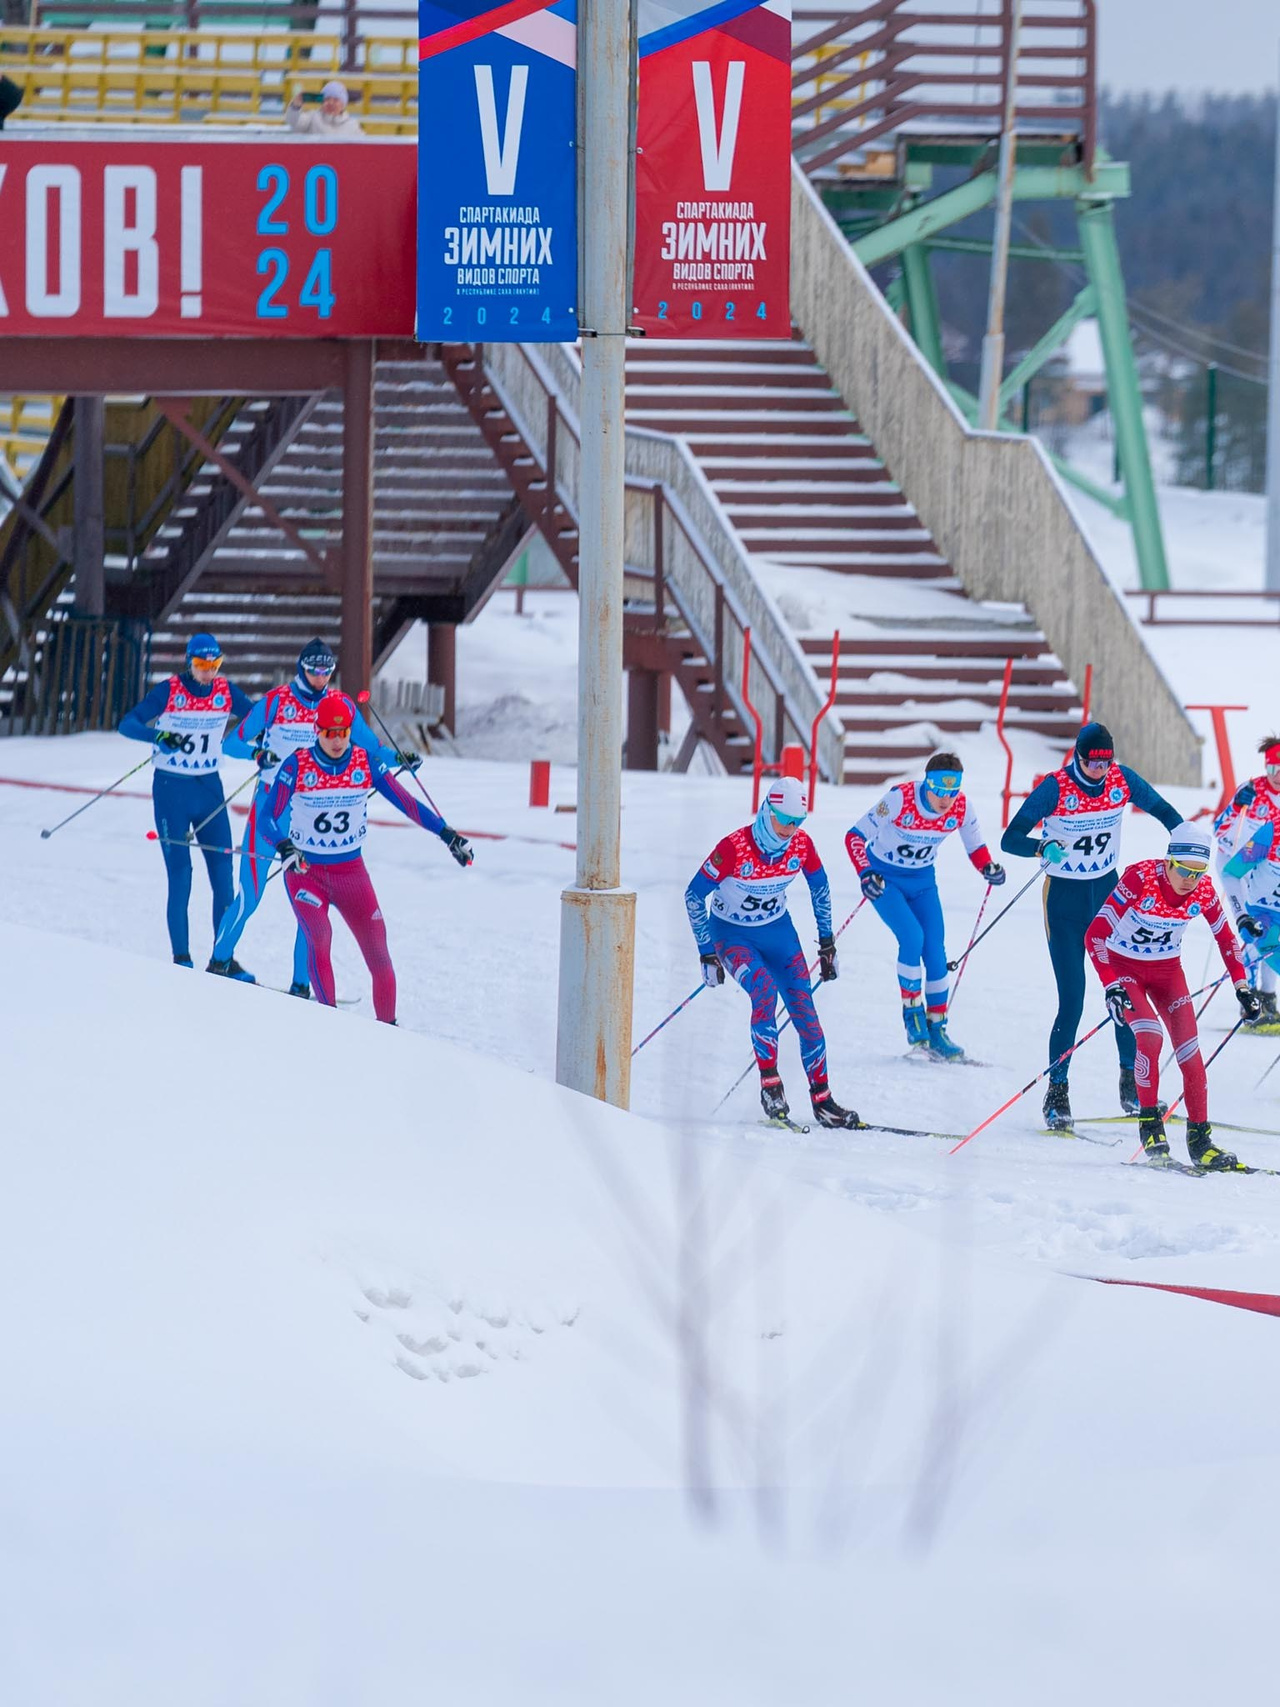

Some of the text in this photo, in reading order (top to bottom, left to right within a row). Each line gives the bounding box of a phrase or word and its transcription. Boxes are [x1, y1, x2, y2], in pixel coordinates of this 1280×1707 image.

[474, 65, 529, 195] V
[692, 61, 745, 191] V
[256, 163, 338, 236] 20
[676, 201, 754, 221] СПАРТАКИАДА
[459, 206, 541, 225] СПАРТАКИАДА
[0, 163, 203, 319] ОВ!
[443, 226, 553, 265] ЗИМНИХ
[661, 221, 767, 261] ЗИМНИХ
[256, 247, 337, 319] 24
[457, 267, 540, 286] ВИДОВ СПОРТА
[673, 262, 755, 282] ВИДОВ СПОРТА
[180, 733, 209, 755] 61
[313, 811, 350, 834] 63
[896, 844, 933, 860] 60
[1072, 832, 1112, 856] 49
[740, 894, 779, 912] 56
[1131, 926, 1174, 945] 54
